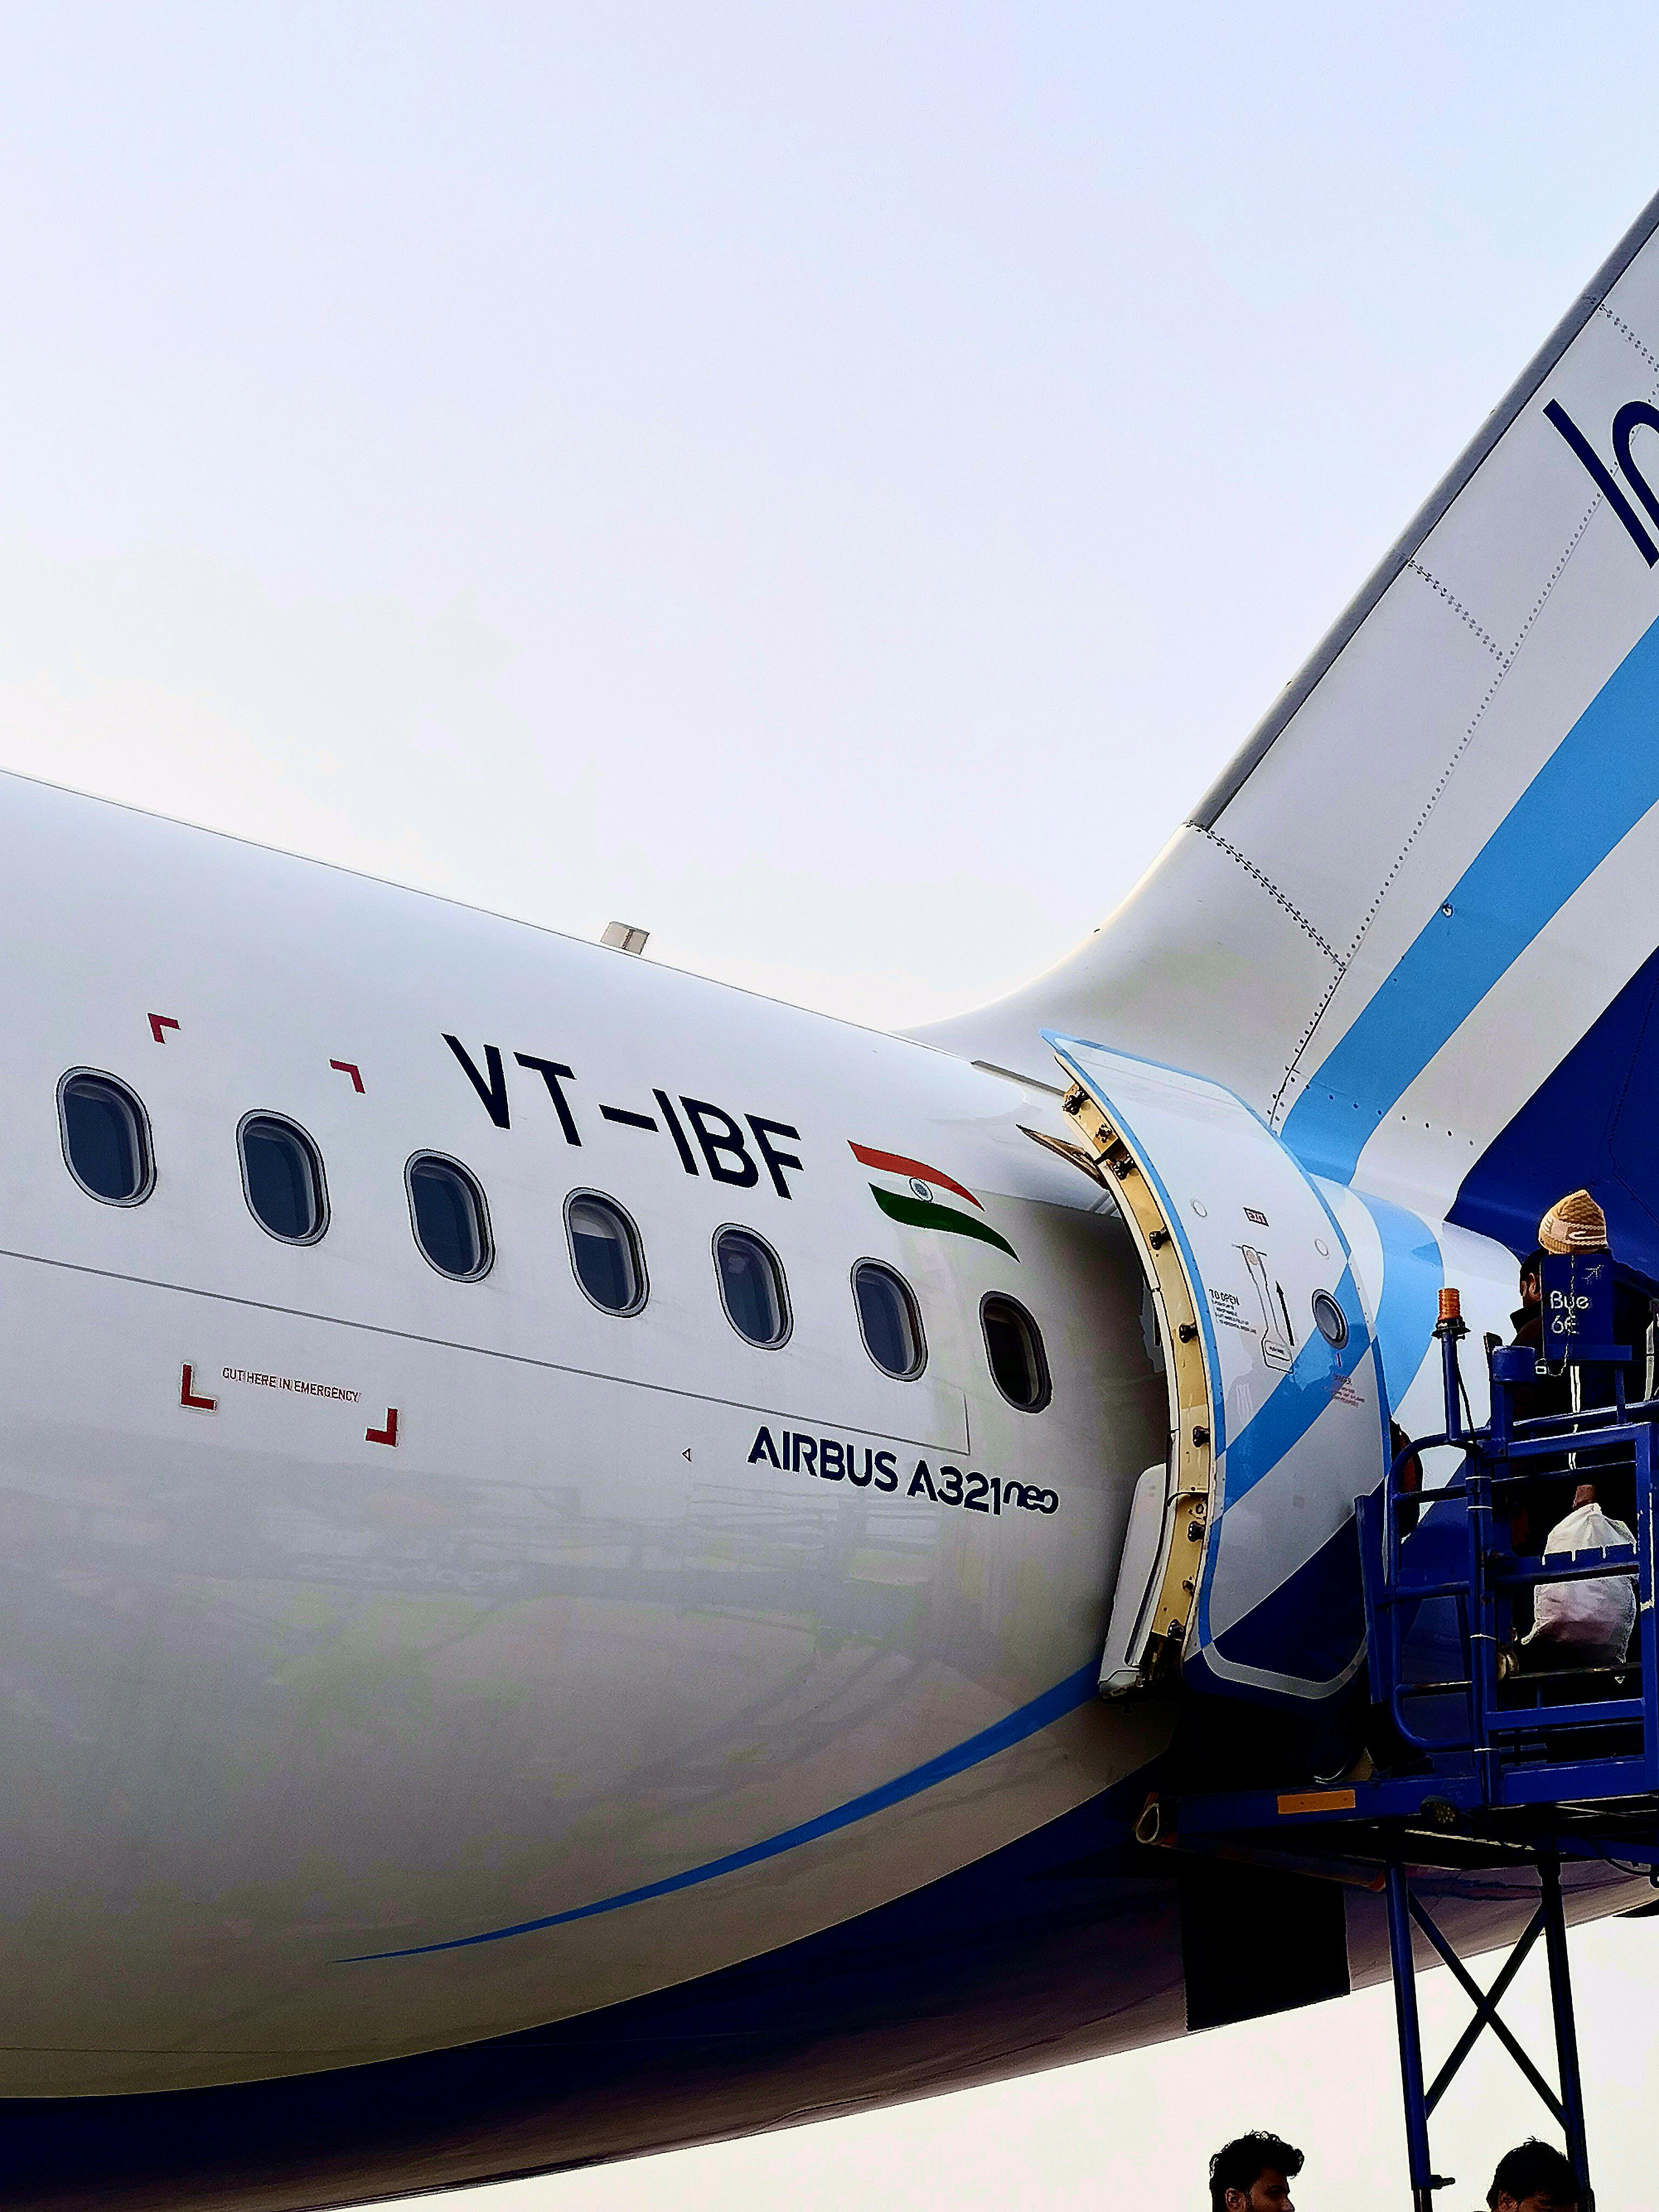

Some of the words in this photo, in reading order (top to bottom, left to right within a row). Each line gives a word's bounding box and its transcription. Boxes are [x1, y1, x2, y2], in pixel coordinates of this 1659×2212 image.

[440, 1033, 804, 1201] VT-IBF
[1209, 1289, 1220, 1299] TO
[1220, 1292, 1240, 1306] OPEN
[1550, 1290, 1589, 1314] Bye
[1551, 1315, 1577, 1334] 6E
[222, 1367, 246, 1381] CUT
[246, 1372, 277, 1388] HERE
[279, 1378, 292, 1391] IN
[293, 1379, 360, 1403] EMERGENCY
[747, 1426, 899, 1492] AIRBUS
[906, 1459, 1059, 1516] A321neo
